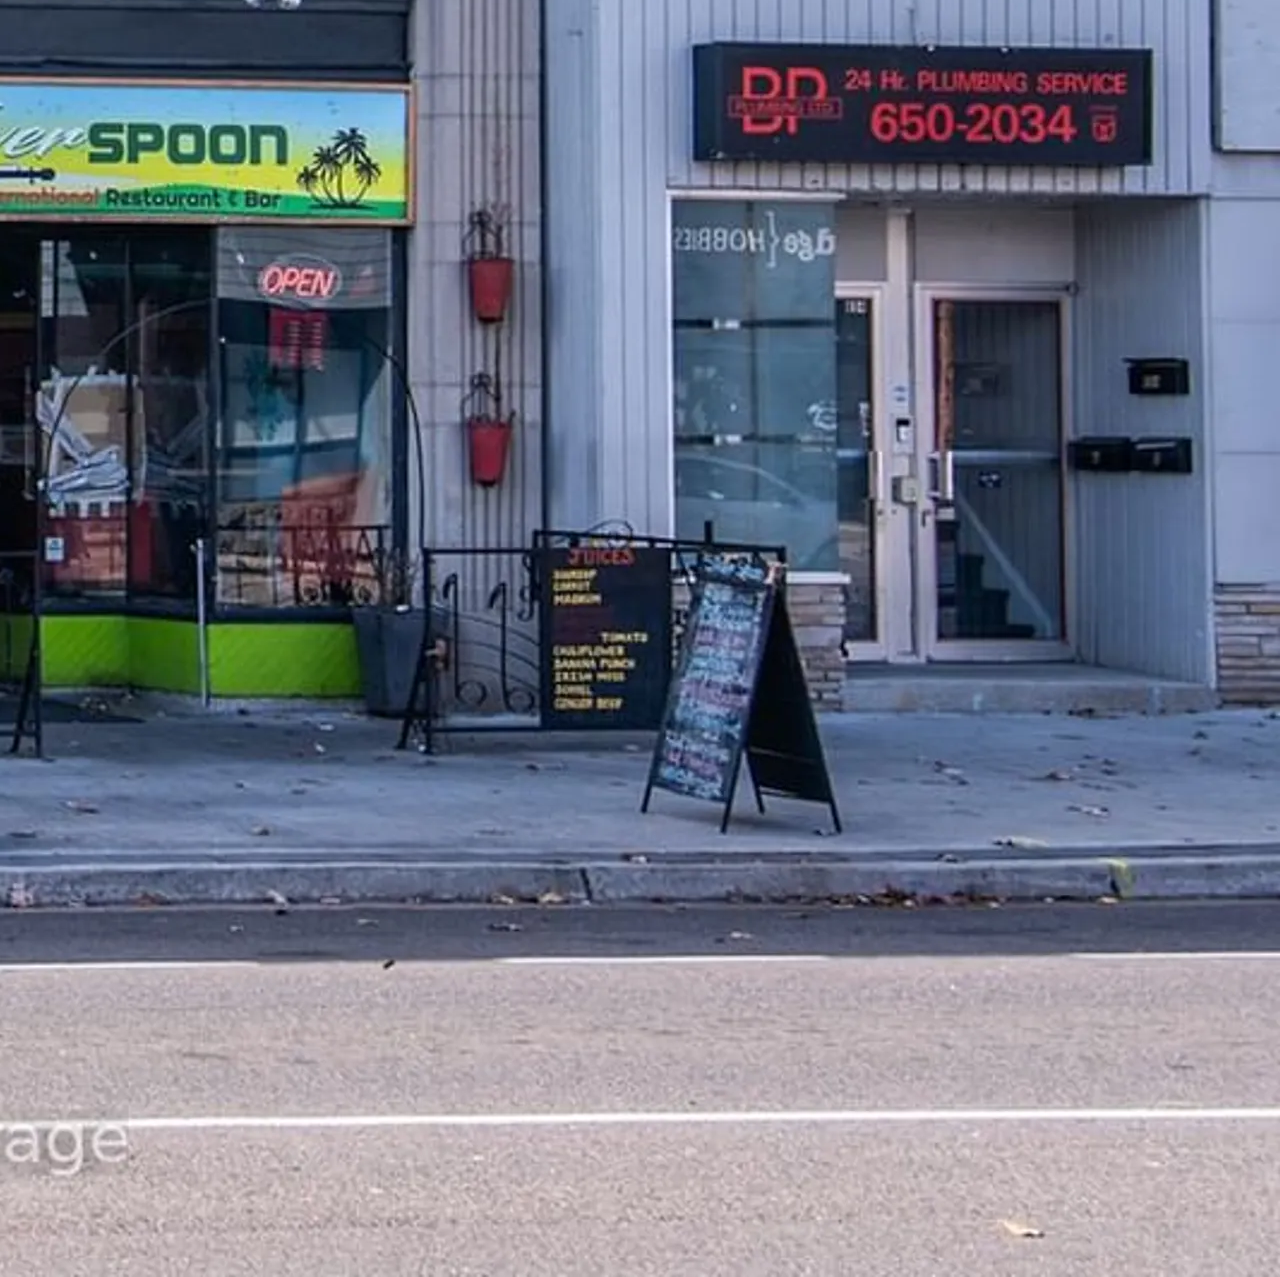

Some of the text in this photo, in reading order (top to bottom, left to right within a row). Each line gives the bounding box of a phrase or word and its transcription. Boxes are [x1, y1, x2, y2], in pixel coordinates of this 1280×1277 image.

[845, 69, 871, 91] 24
[918, 70, 1027, 93] PLUMBING
[1037, 73, 1127, 95] SERVICE
[871, 103, 1076, 142] 650-2034
[106, 189, 220, 206] Restaurant
[245, 190, 282, 208] Bar
[262, 267, 334, 297] OPEN
[568, 550, 634, 566] JUICES
